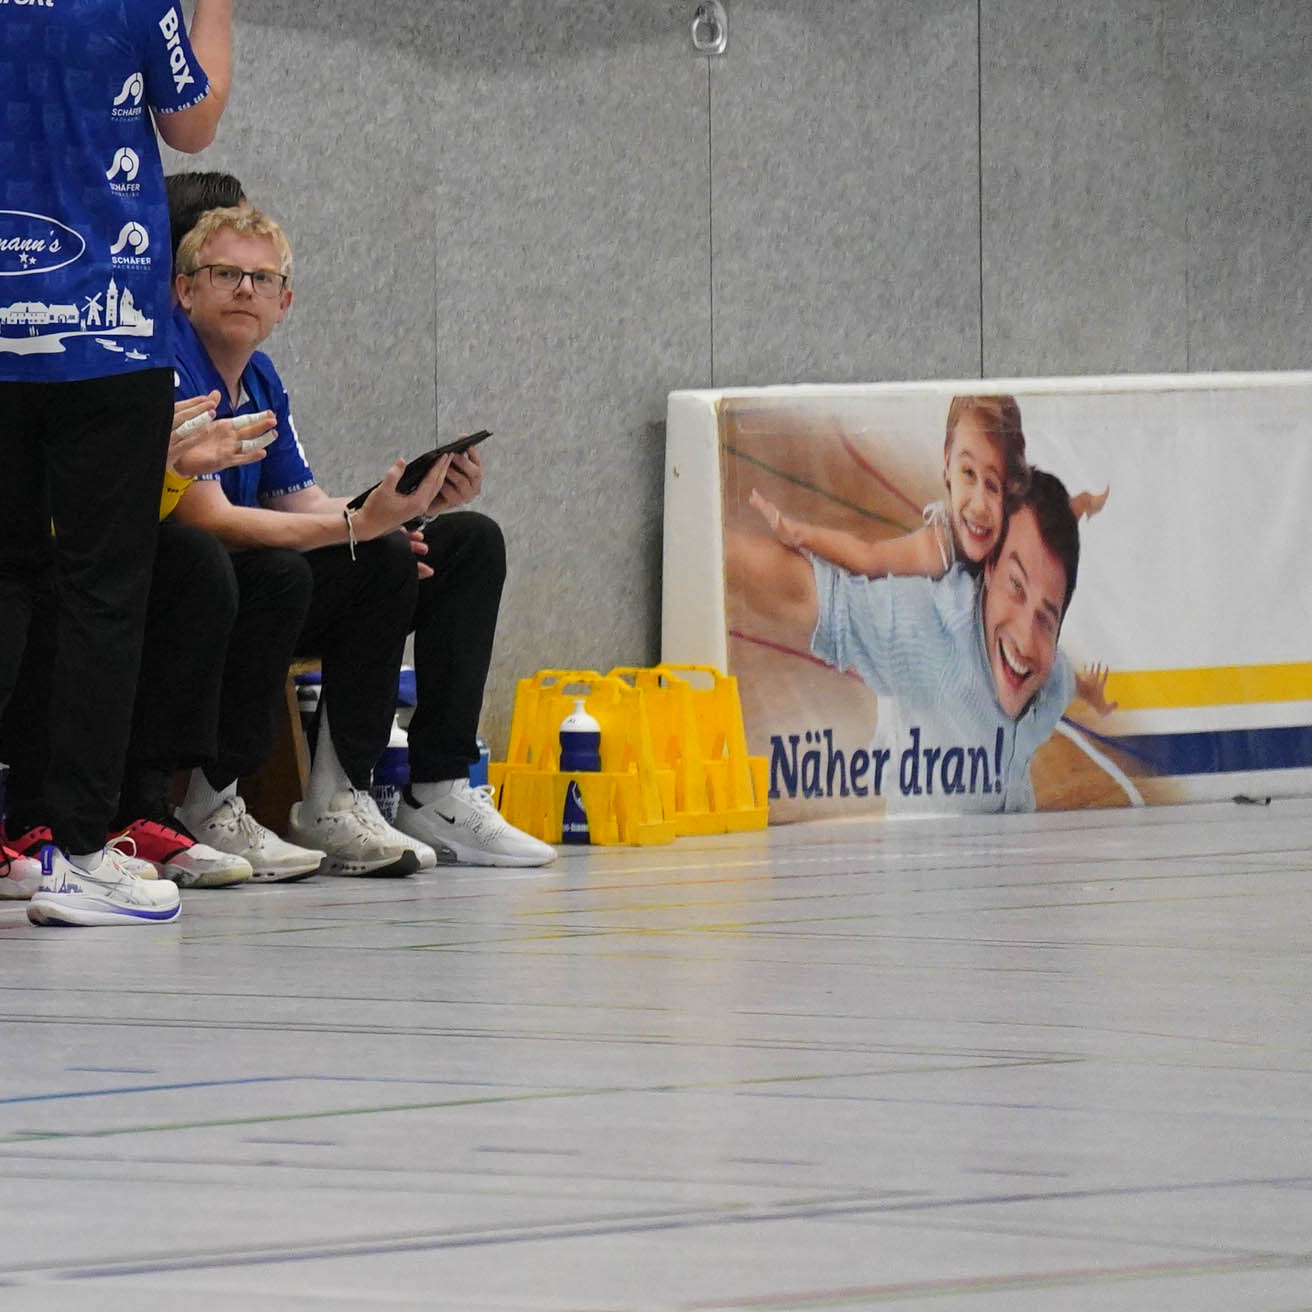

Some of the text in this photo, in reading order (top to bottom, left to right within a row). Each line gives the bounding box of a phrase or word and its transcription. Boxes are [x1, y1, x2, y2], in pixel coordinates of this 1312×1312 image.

[159, 6, 195, 93] Brax
[111, 255, 152, 266] SCHÄFER
[769, 726, 1004, 801] Näher dran!
